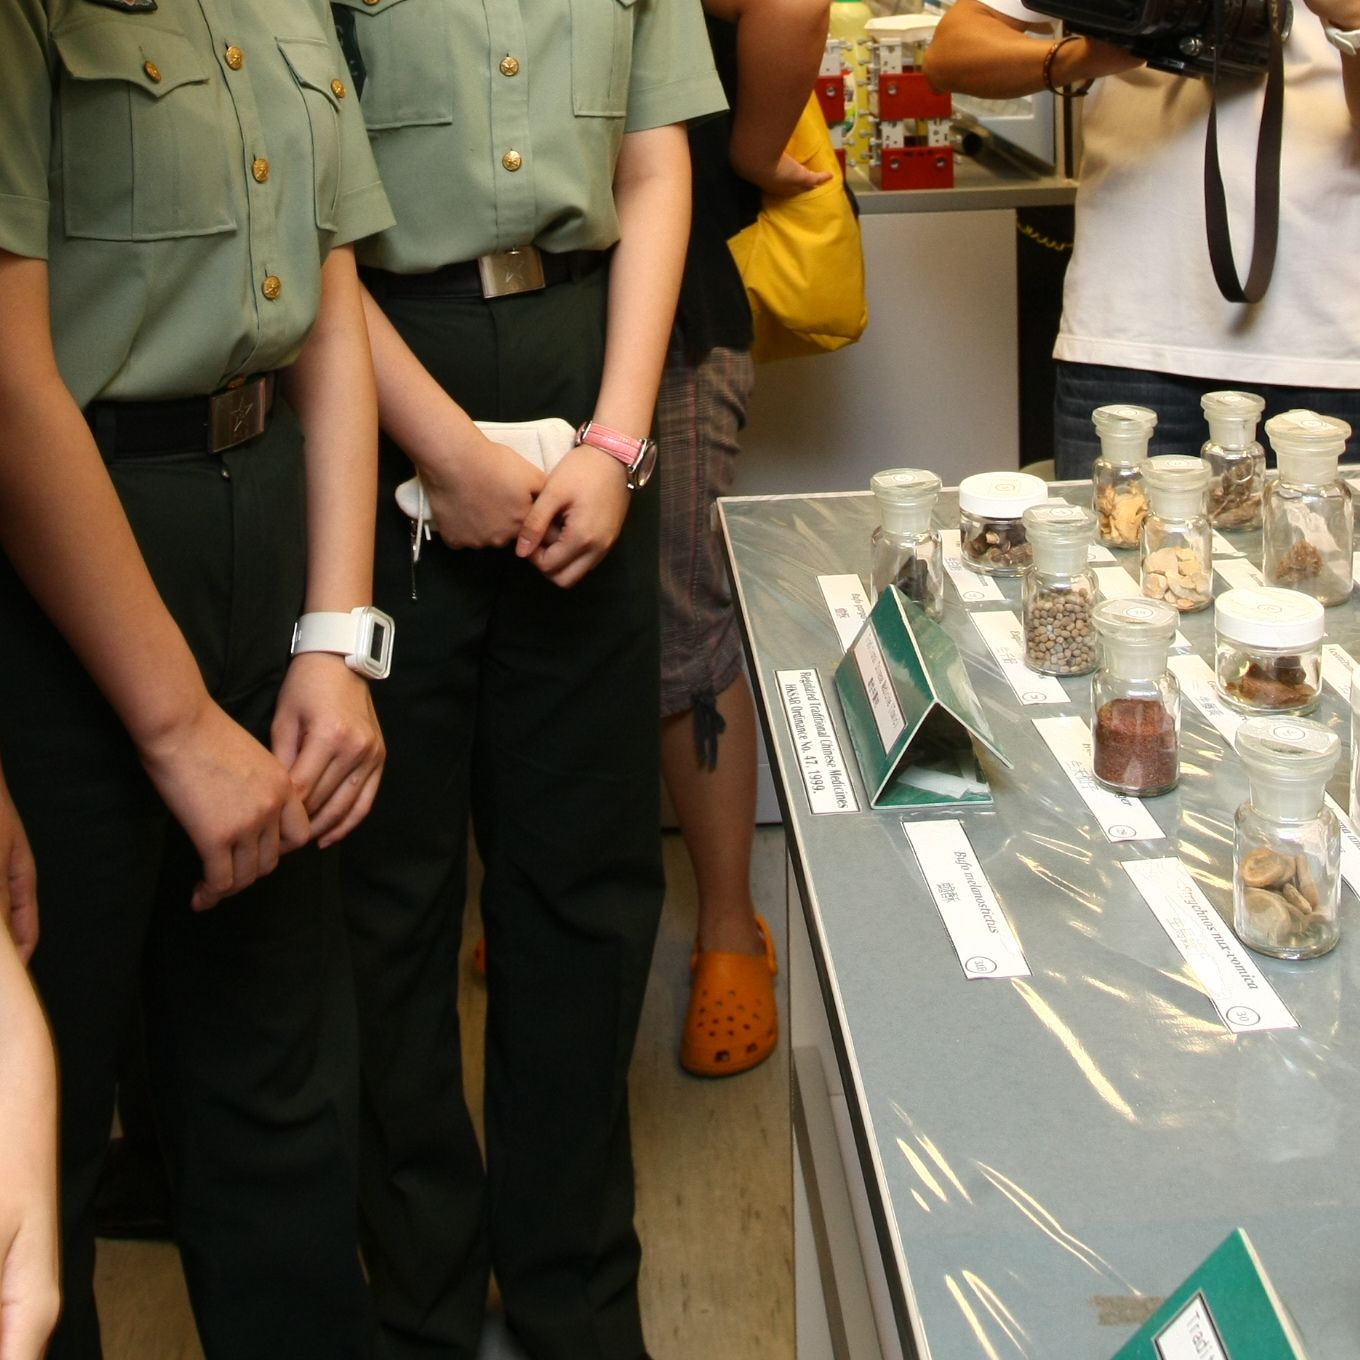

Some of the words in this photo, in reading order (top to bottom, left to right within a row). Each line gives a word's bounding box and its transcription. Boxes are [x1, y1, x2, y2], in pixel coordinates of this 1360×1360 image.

[785, 684, 799, 706] HKSAR
[791, 705, 809, 740] Ordinance
[800, 671, 818, 708] Regulated
[811, 708, 828, 738] Traditional
[820, 739, 835, 768] Chinese
[828, 770, 849, 809] Medicines
[801, 738, 811, 754] No.
[807, 769, 825, 795] 1999.
[953, 850, 973, 871] Bufo
[964, 871, 1000, 934] melanostictus
[1211, 930, 1259, 990] nux-vomica
[1235, 1011, 1250, 1023] 30
